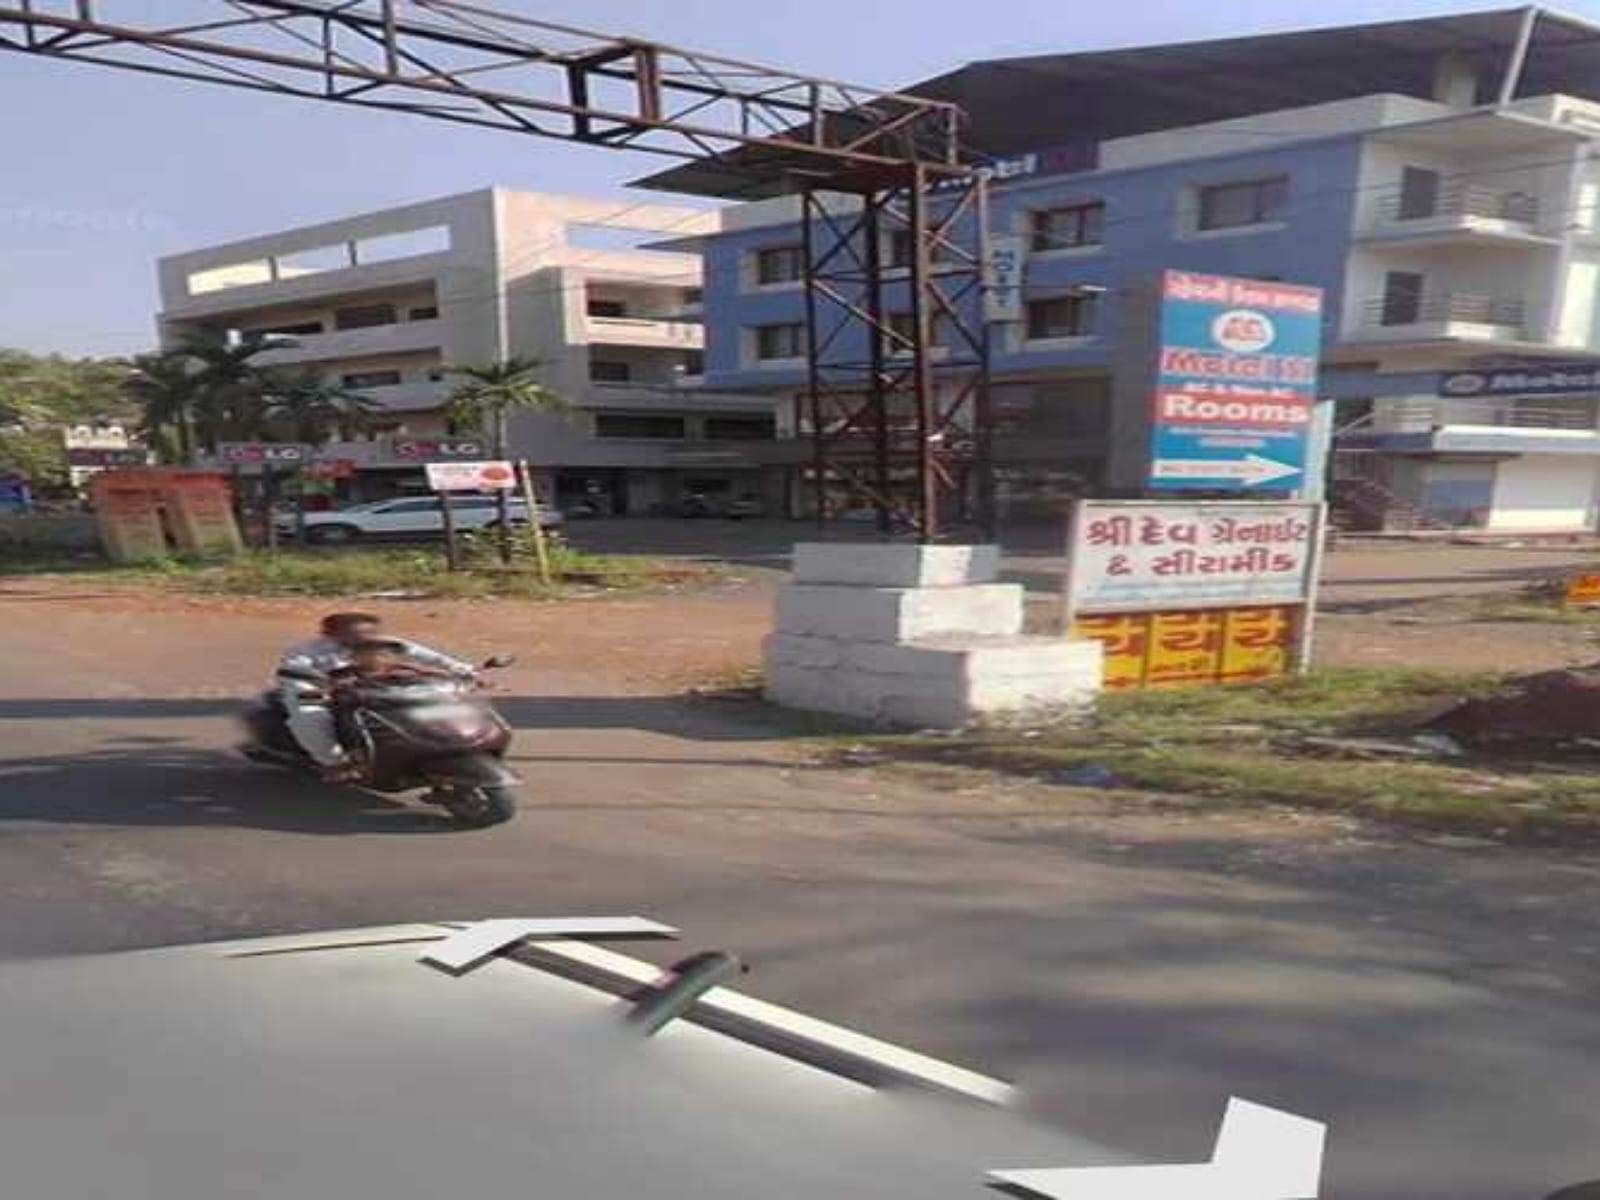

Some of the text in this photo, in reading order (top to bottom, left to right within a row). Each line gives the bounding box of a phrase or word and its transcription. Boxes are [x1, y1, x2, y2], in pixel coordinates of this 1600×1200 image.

[1162, 395, 1310, 424] Rooms
[264, 447, 301, 460] LG
[438, 443, 480, 455] LG
[1086, 515, 1132, 546] શ્રી
[1139, 516, 1197, 546] દેવ
[1150, 547, 1296, 577] સીરામીક
